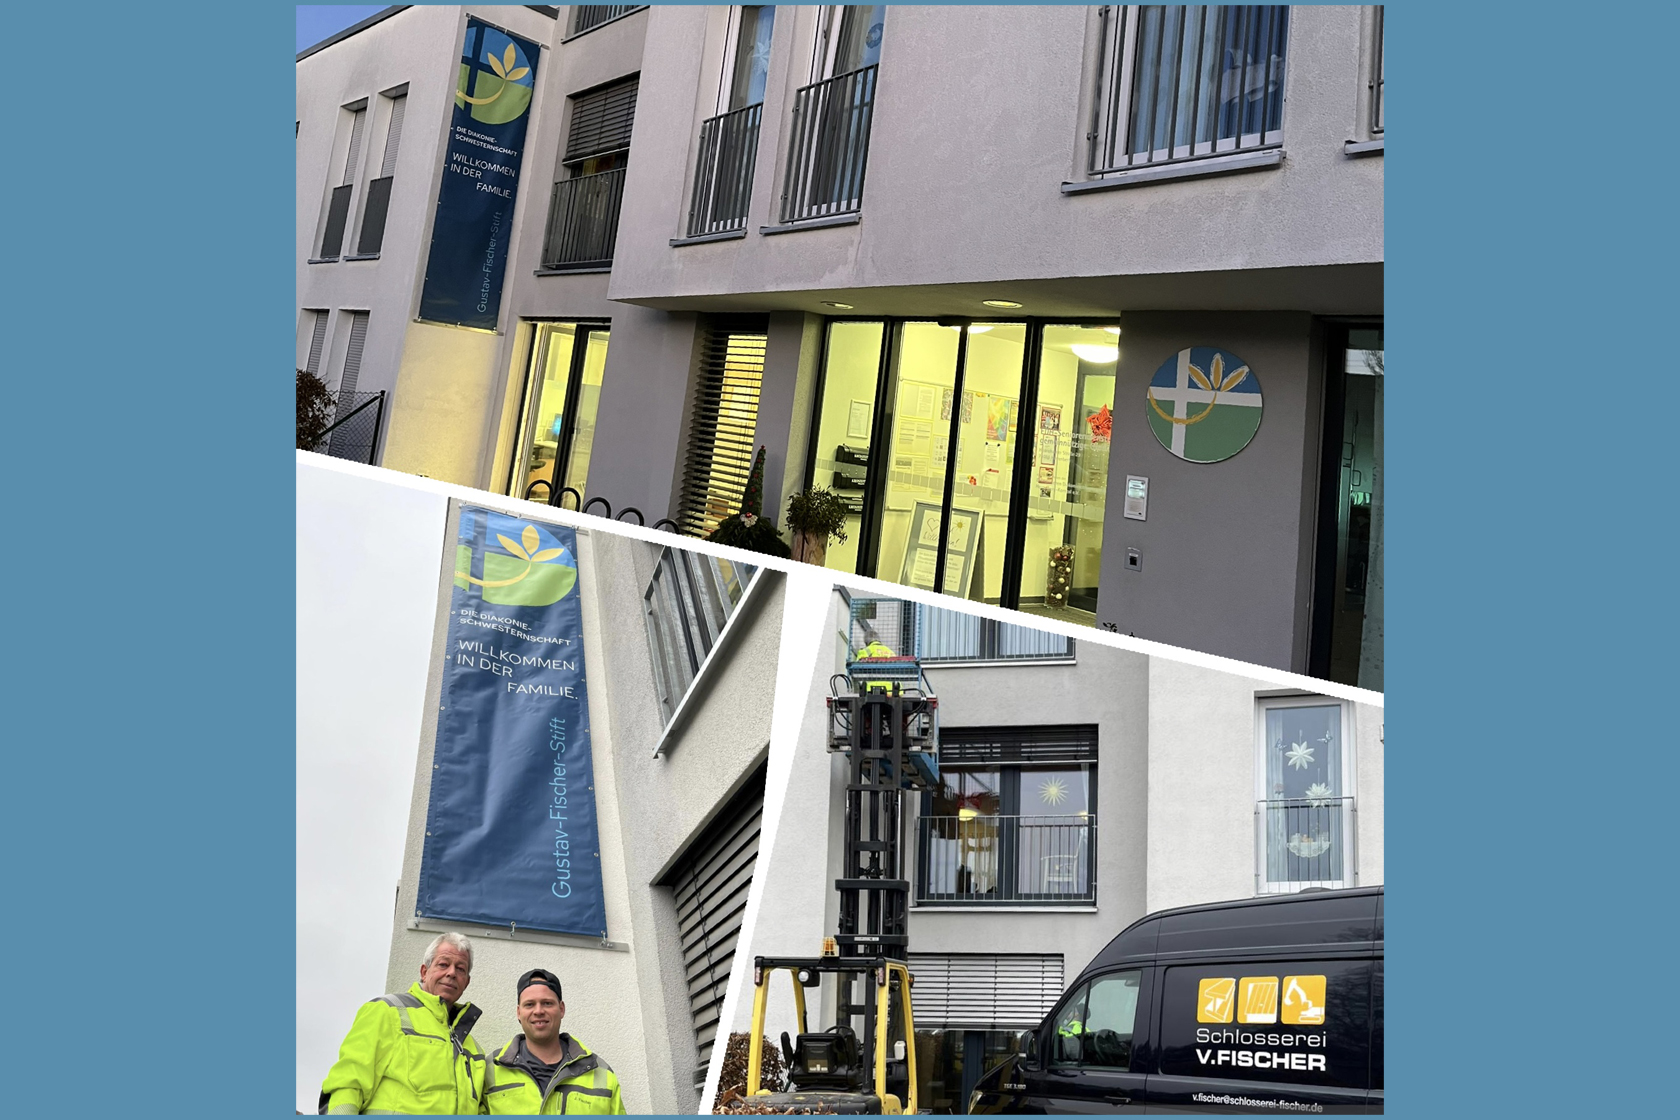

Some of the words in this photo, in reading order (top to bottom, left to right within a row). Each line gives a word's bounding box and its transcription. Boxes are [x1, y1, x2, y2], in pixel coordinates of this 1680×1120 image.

[455, 134, 517, 157] SCHWESTERNSCHAFT
[456, 126, 467, 134] DIE
[468, 130, 497, 143] DIAKONIE-
[451, 163, 461, 173] IN
[462, 166, 482, 179] DER
[453, 152, 516, 177] WILLKOMMEN
[476, 182, 512, 199] FAMILIE.
[477, 211, 502, 313] Gustav-Fischer-Stift
[461, 609, 478, 618] DIE
[480, 613, 532, 631] DIAKONIE-
[460, 618, 571, 646] SCHWESTERNSCHAFT
[457, 654, 475, 667] IN
[480, 658, 513, 678] DER
[459, 639, 575, 671] WILLKOMMEN
[507, 682, 578, 700] FAMILIE.
[549, 717, 571, 898] Gustav-Fischer-Stift
[1196, 1028, 1327, 1048] Schlosserei
[1196, 1049, 1326, 1071] V.FISCHER
[1192, 1092, 1323, 1113] v.fischer@schlosserei-fischer.de
